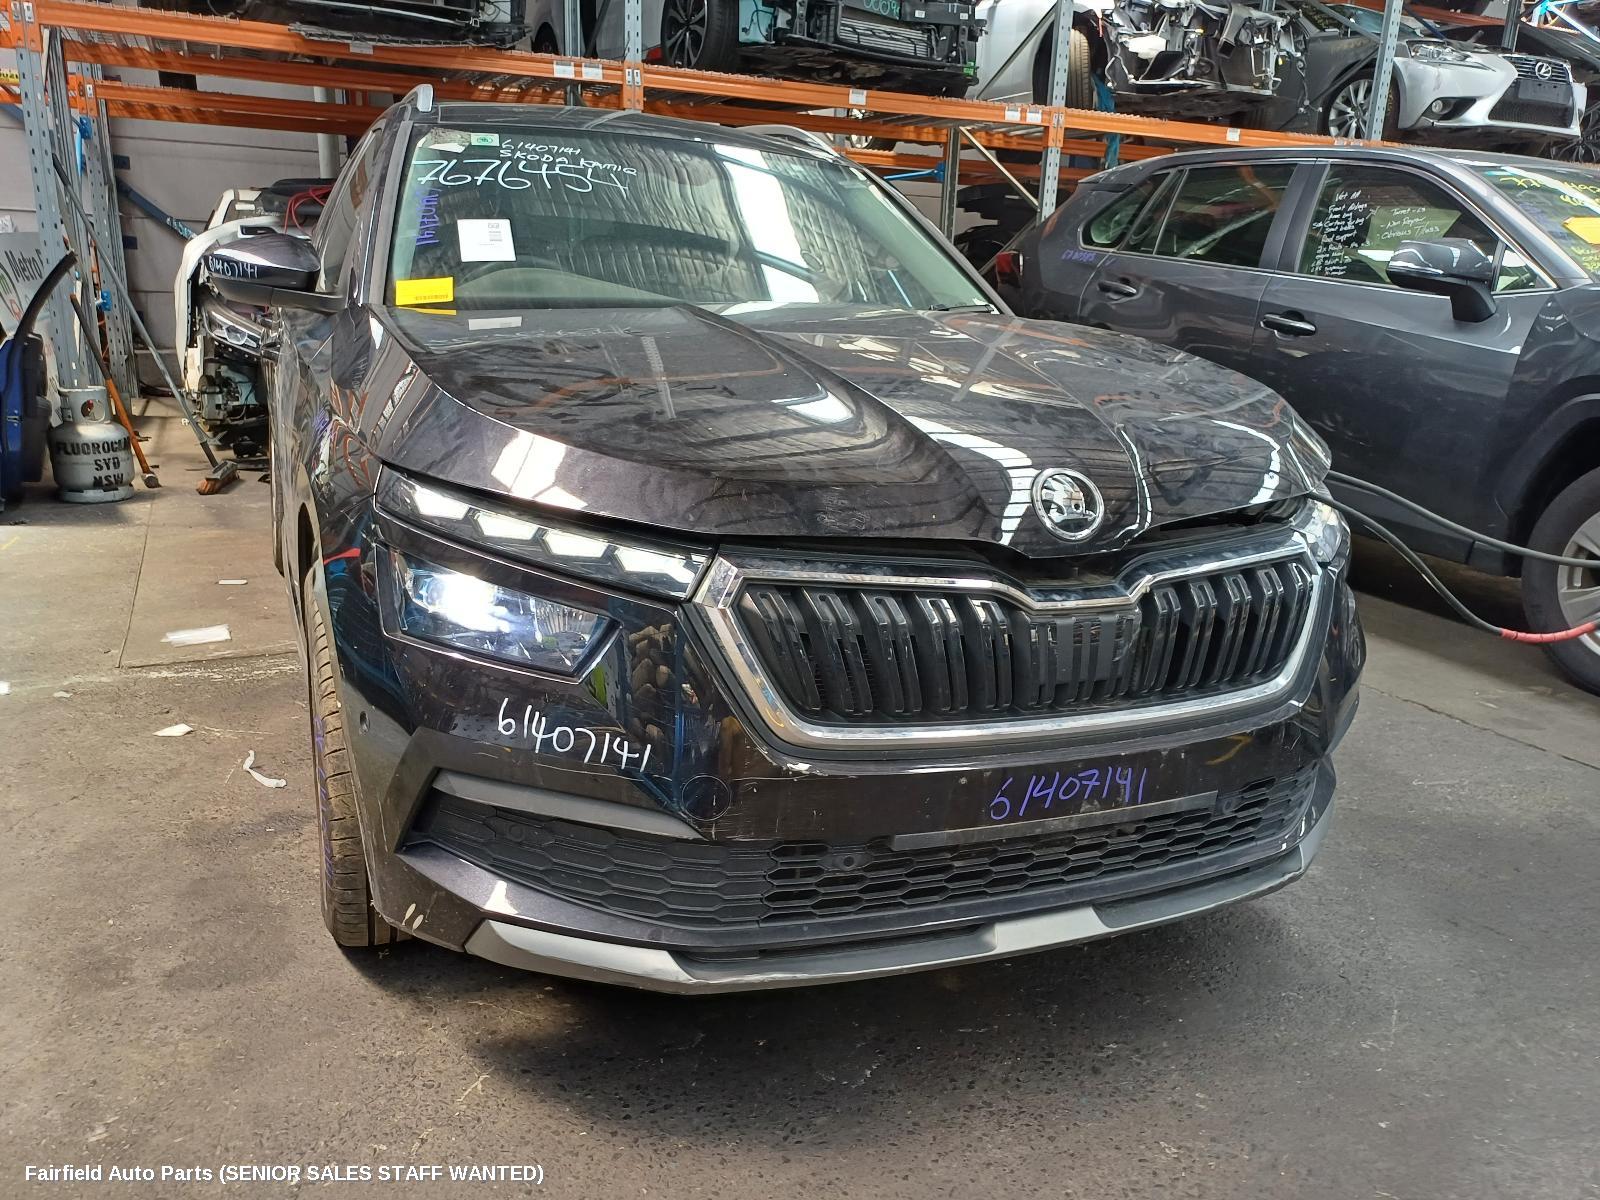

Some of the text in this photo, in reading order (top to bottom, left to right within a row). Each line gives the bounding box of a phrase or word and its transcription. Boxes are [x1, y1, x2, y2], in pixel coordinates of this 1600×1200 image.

[499, 149, 569, 165] SKODA
[501, 138, 582, 157] 61407141
[411, 159, 629, 200] 7676454
[4, 248, 43, 283] Metro
[94, 456, 121, 472] SYD
[92, 473, 124, 488] NSW
[497, 697, 652, 773] 61407141
[989, 766, 1147, 821] 61407141
